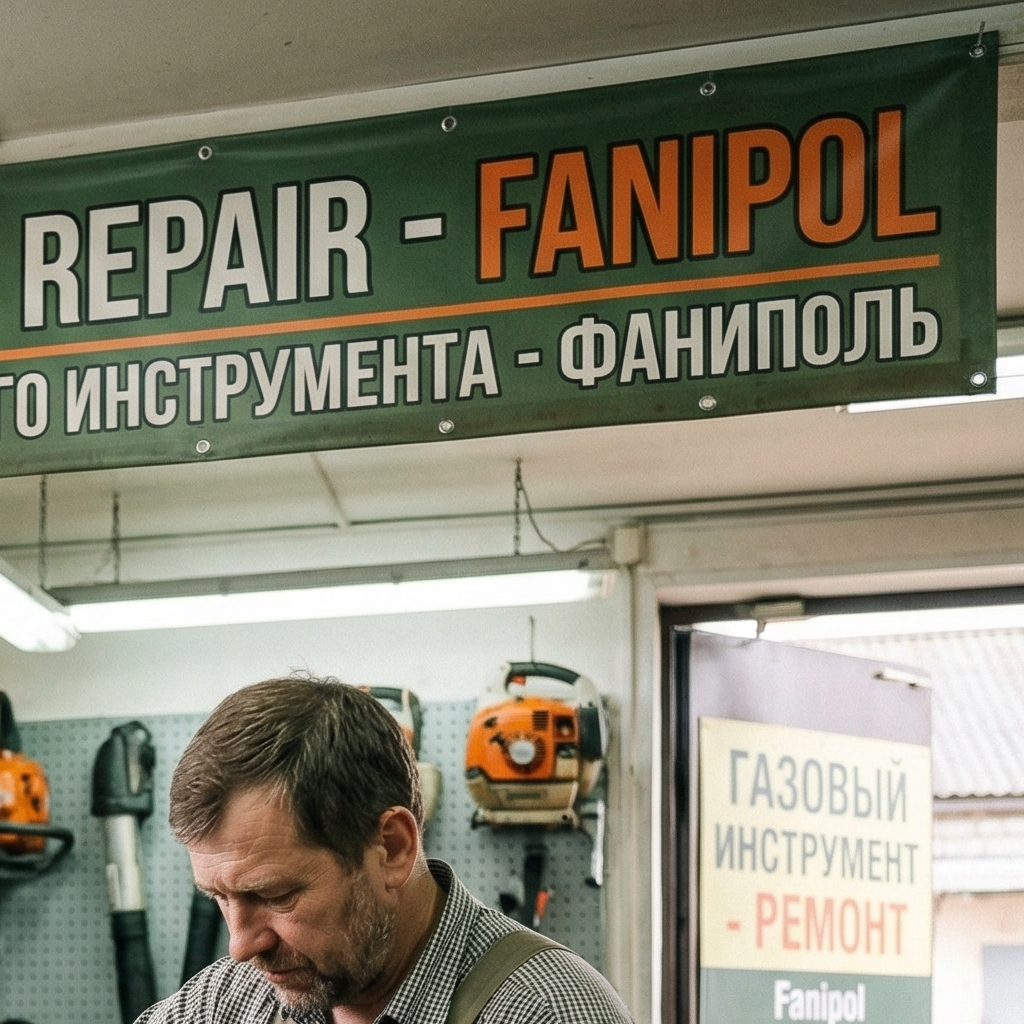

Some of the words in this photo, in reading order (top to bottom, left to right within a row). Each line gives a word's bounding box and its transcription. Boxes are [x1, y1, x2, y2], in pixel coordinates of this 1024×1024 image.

[24, 180, 370, 328] REPAIR
[404, 217, 443, 240] -
[480, 110, 938, 279] FANIPOL
[67, 329, 500, 434] ИНСТРУМЕНТА
[518, 350, 540, 365] -
[561, 287, 940, 386] ФАНИПОЛЬ
[730, 749, 907, 822] ГАЗОВЫЙ
[715, 823, 919, 884] ИНСТРУМЕНТ
[726, 921, 741, 931] -
[756, 892, 908, 955] РЕМОНТ
